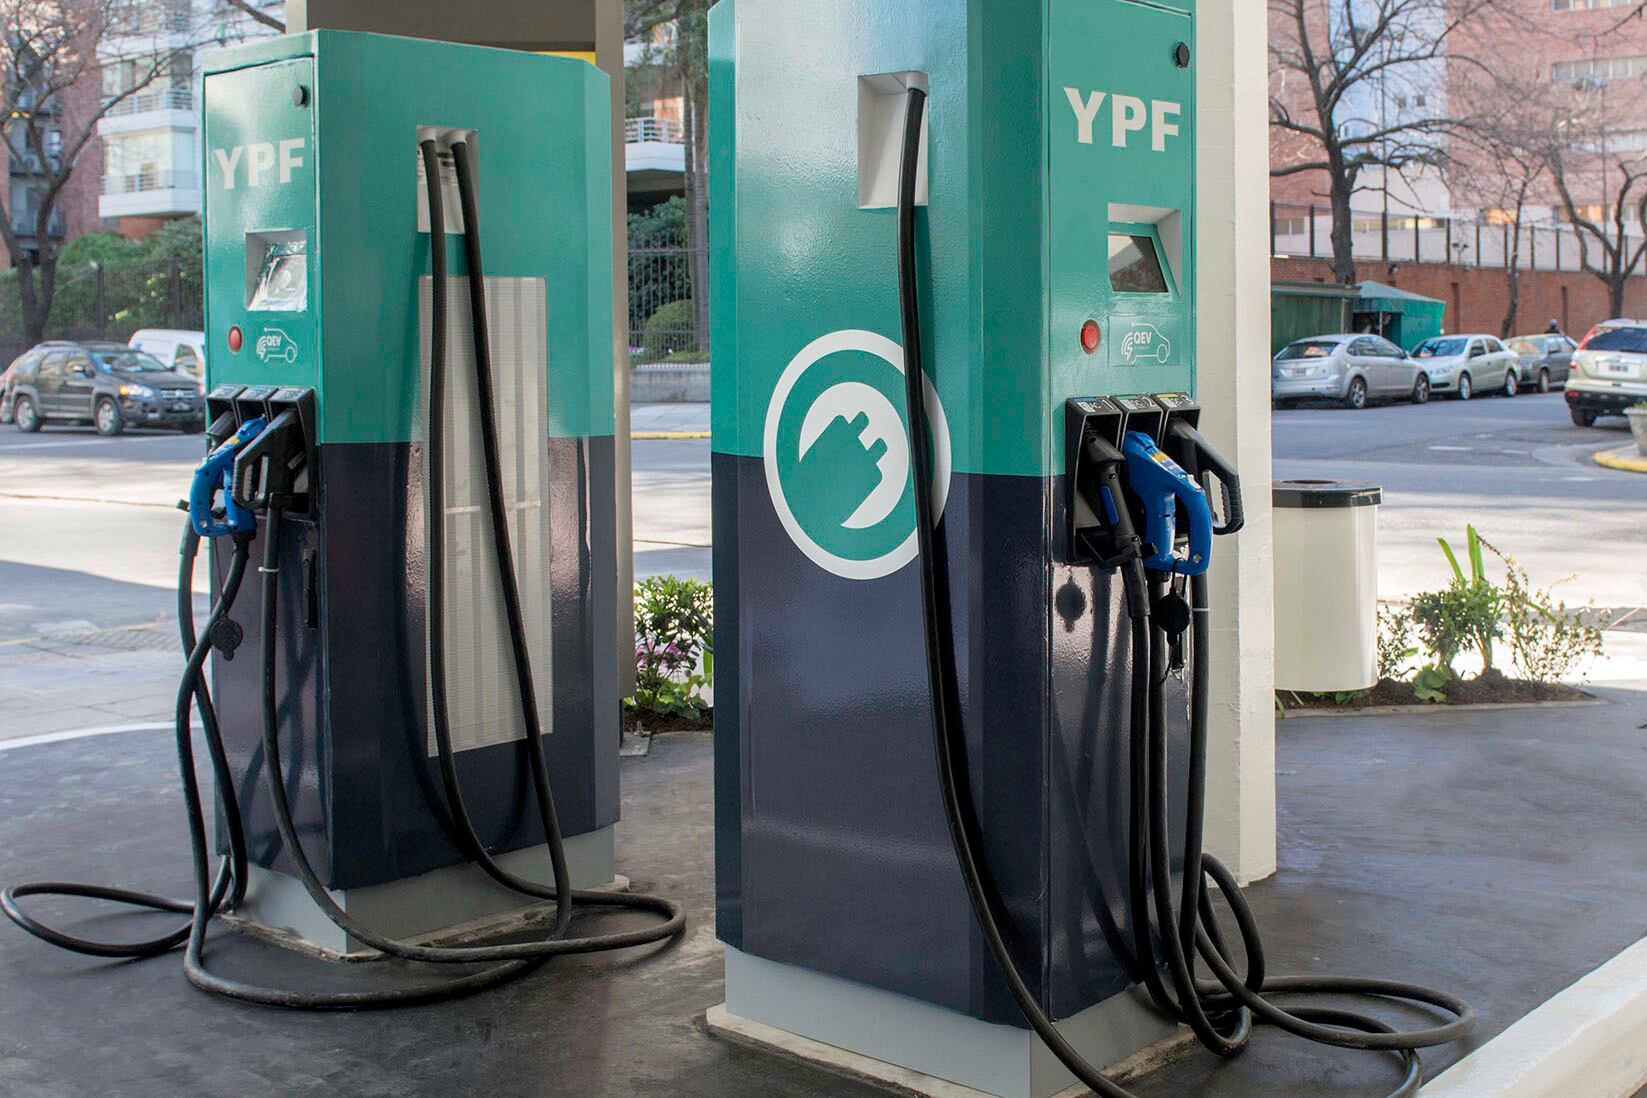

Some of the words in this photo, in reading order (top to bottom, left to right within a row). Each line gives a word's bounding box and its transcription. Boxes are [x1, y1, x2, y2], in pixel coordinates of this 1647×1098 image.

[1063, 86, 1181, 152] YPF
[213, 137, 305, 190] YPF
[1133, 331, 1152, 345] QEV
